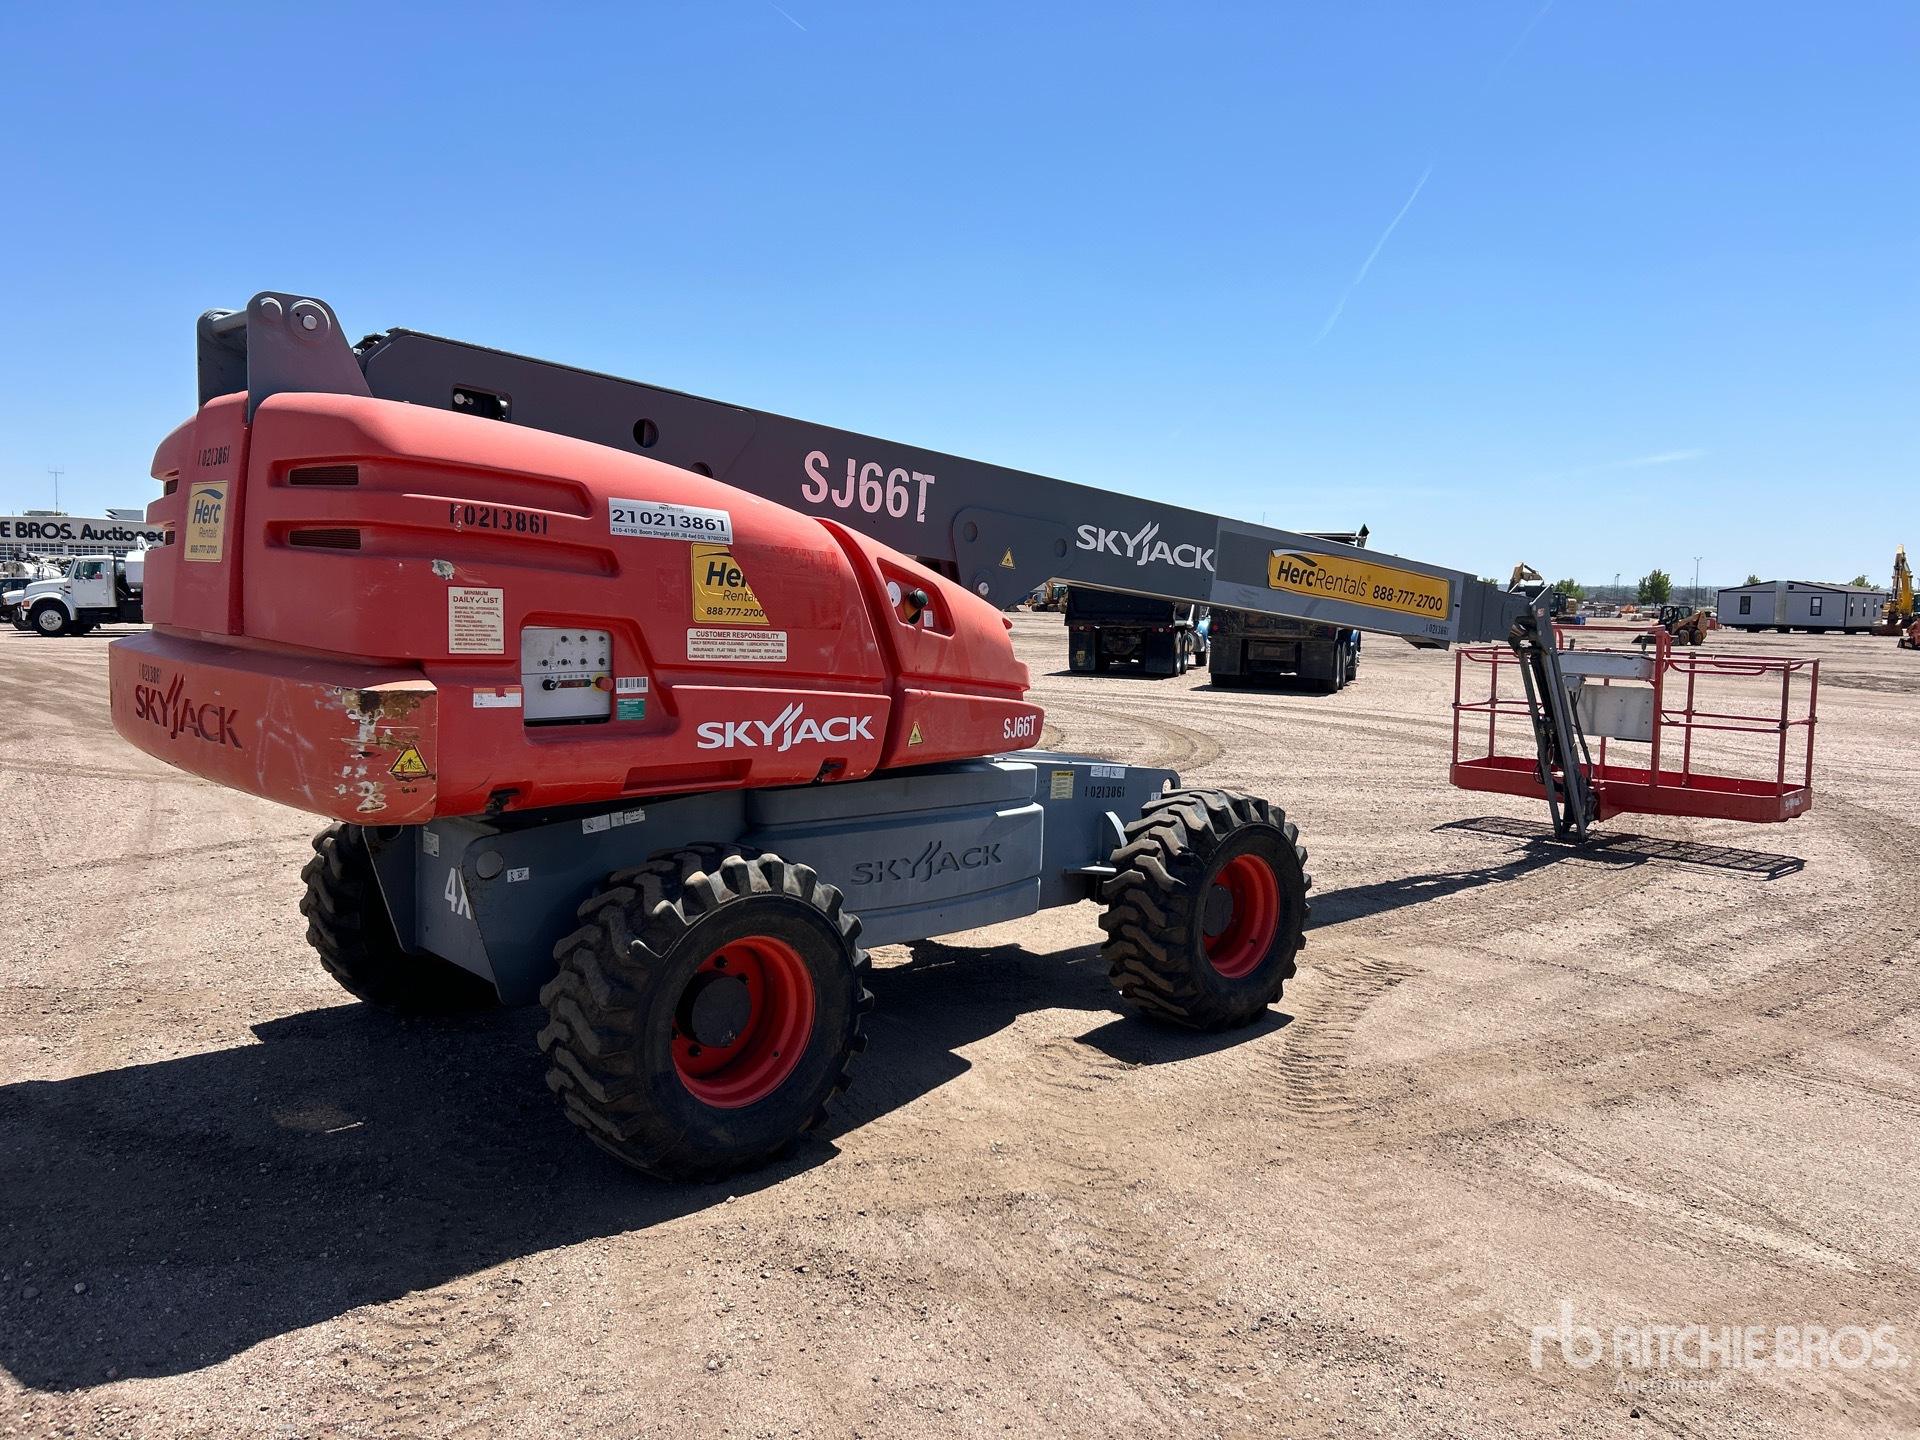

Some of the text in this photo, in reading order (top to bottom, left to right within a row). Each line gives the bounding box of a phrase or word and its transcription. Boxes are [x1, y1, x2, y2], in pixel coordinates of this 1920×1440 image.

[801, 450, 936, 523] SJ66T
[192, 499, 222, 524] Herc
[612, 509, 726, 532] 210213861
[15, 521, 77, 540] BROS.
[199, 526, 217, 539] Rentals
[653, 529, 670, 538] Straight
[1075, 521, 1216, 573] SKYJACK
[1372, 584, 1443, 612] 888-777-2700
[706, 606, 765, 617] 888-777-2700
[696, 630, 780, 639] CUSTOMER RESPONSIBILITY
[135, 673, 243, 750] SKYJACK
[696, 702, 875, 752] SKYJACK
[1003, 714, 1037, 740] SJ66T
[850, 840, 1002, 886] SKYJACK
